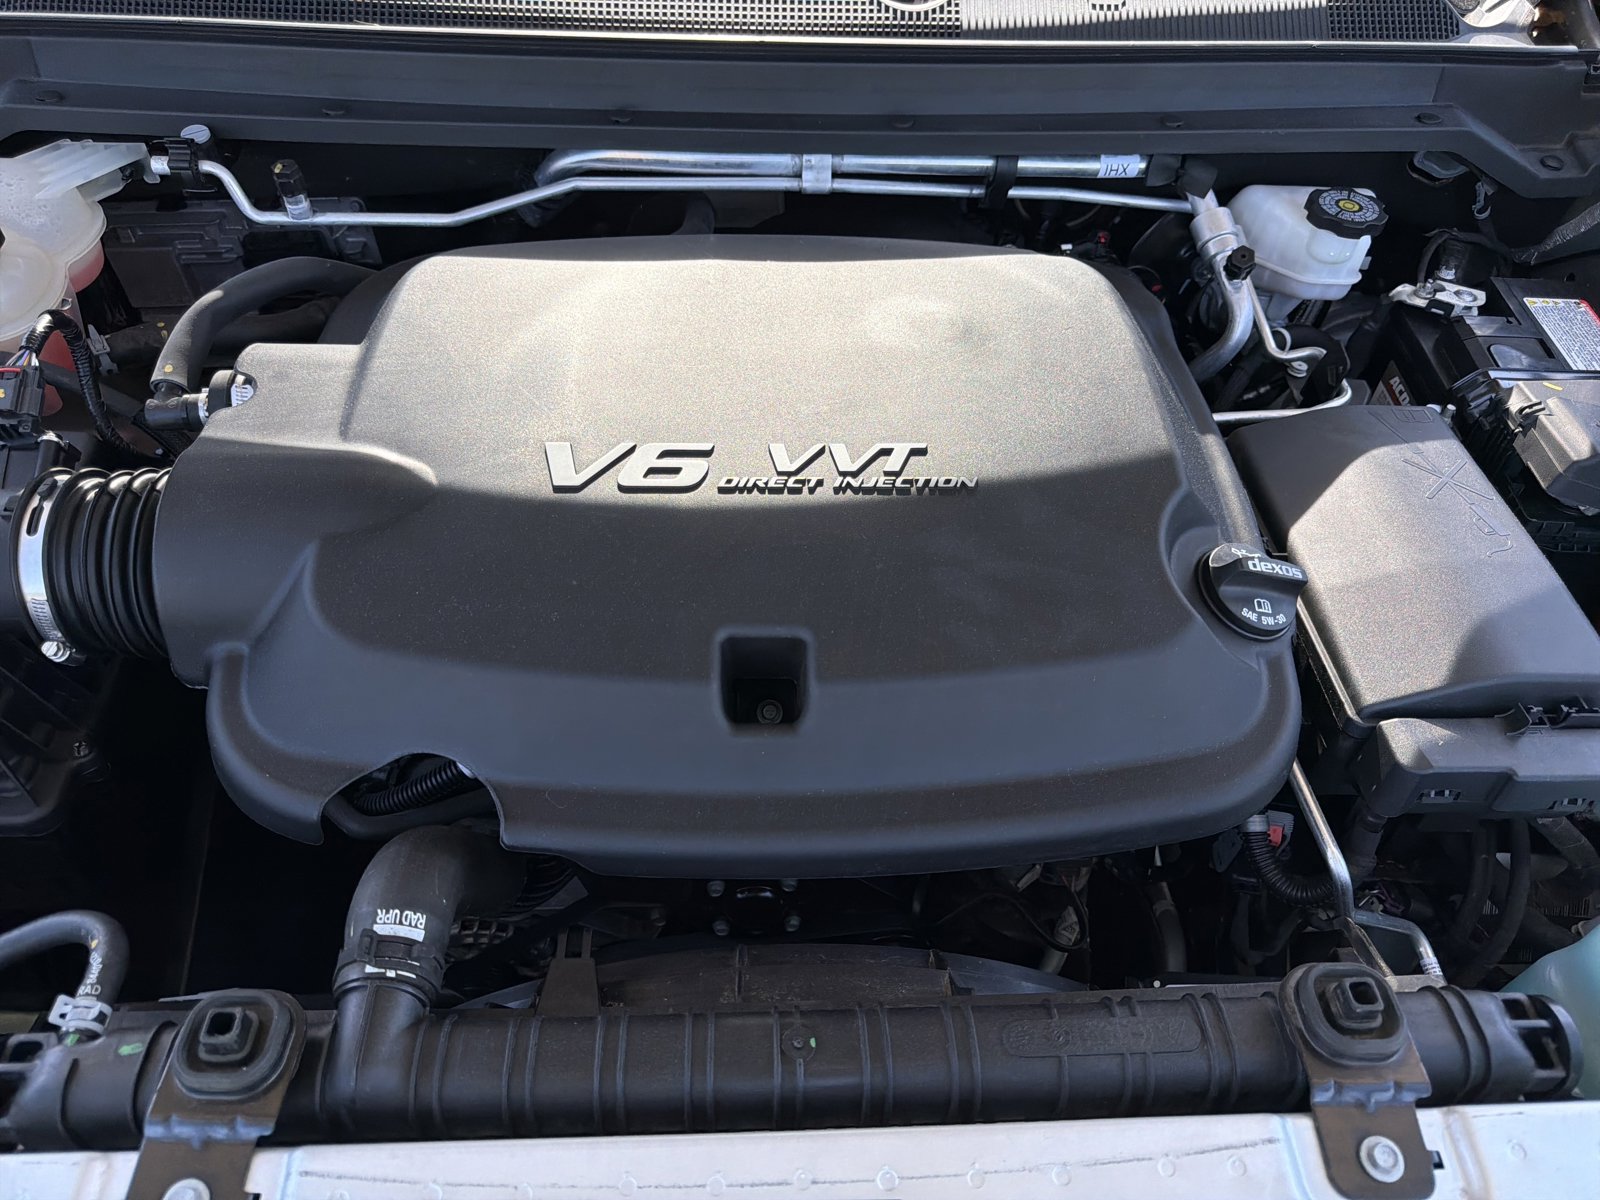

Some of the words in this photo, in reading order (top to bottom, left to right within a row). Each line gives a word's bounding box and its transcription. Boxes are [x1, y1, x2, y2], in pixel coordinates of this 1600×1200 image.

[1389, 376, 1411, 406] ACD
[545, 442, 715, 493] V6
[768, 443, 928, 475] VVT
[717, 475, 824, 492] DIRECT
[833, 475, 979, 493] INJECTION
[1247, 558, 1303, 579] dexos
[1241, 607, 1258, 622] SAE
[1261, 613, 1287, 625] 5W-30
[376, 908, 401, 924] UPR
[401, 910, 426, 929] RAD
